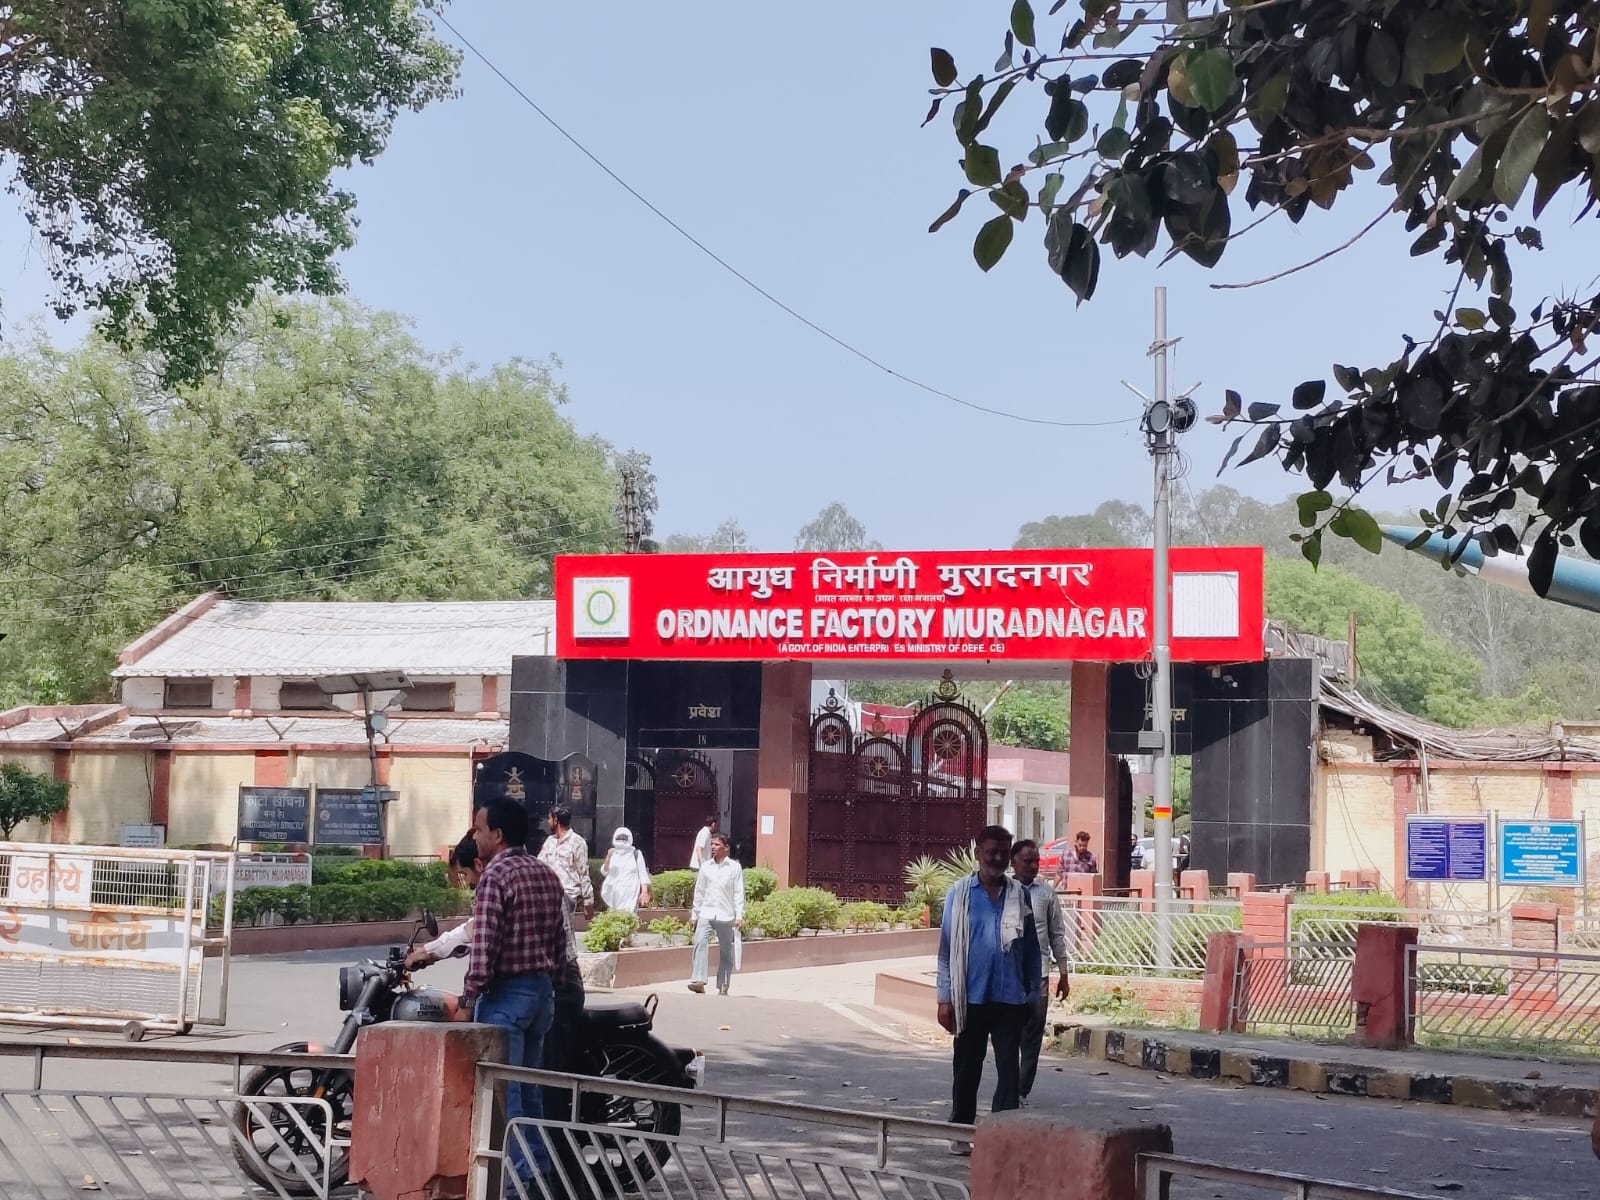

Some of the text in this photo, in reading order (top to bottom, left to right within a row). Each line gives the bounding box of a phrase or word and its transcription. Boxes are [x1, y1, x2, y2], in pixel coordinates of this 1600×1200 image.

[707, 556, 1094, 599] आयुध निर्माणी मुरादनगर
[656, 607, 1148, 639] ORDNANCE FACTORY MURADNAGAR
[812, 643, 824, 653] OF
[824, 643, 847, 653] INDIA
[907, 643, 947, 653] MINISTRY
[948, 643, 961, 653] OF
[961, 643, 1005, 654] DEFECE)
